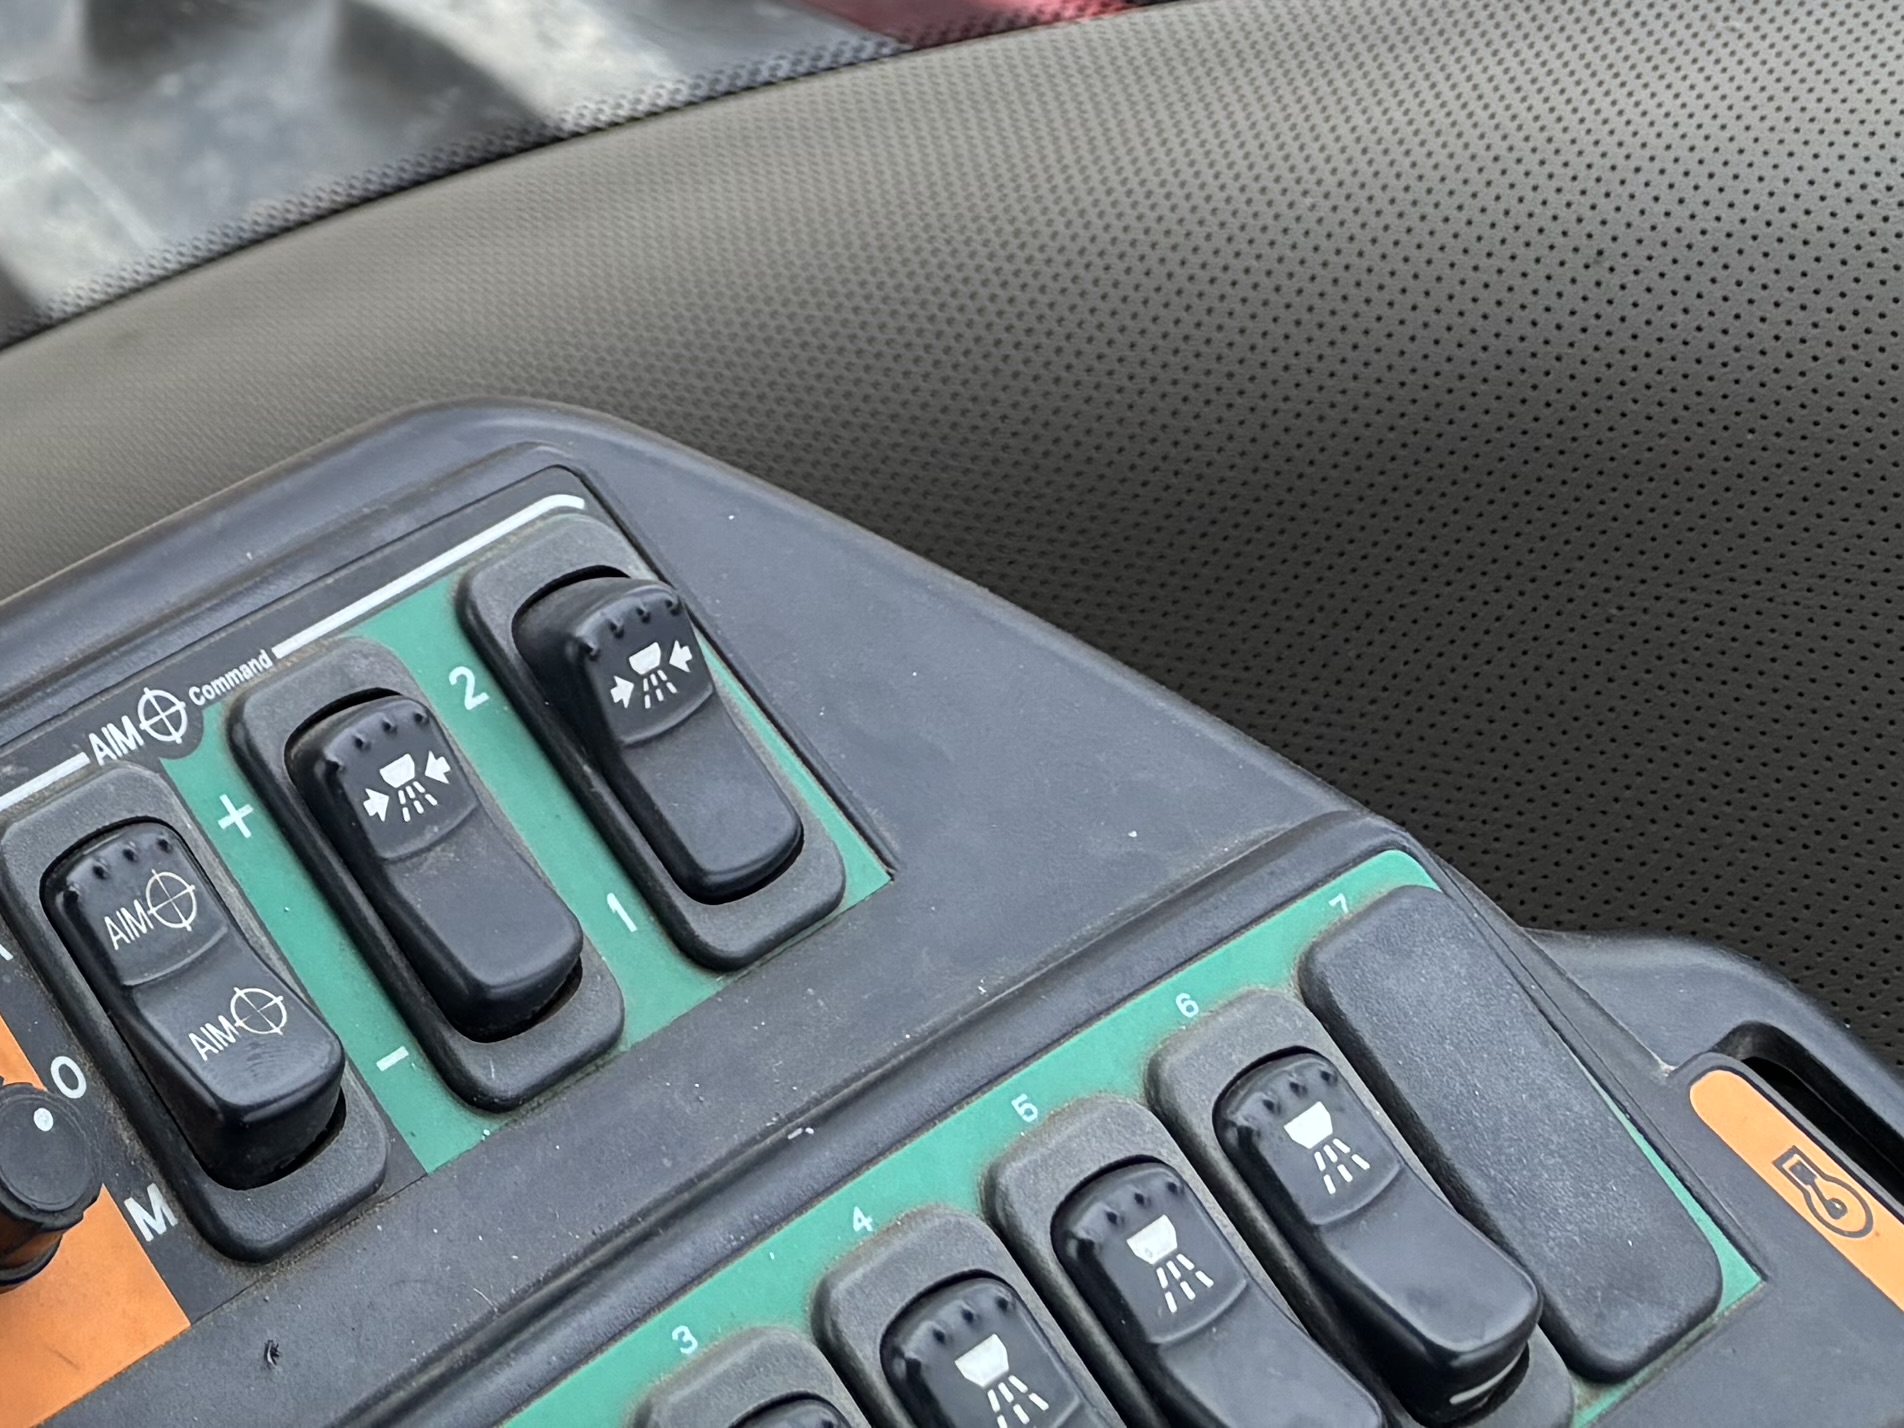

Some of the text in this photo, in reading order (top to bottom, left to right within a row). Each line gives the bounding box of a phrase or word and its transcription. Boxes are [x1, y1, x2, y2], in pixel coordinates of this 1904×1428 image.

[88, 650, 272, 767] AIM Command
[449, 666, 490, 711] 2
[103, 897, 152, 950] AIM
[606, 892, 637, 933] 1
[1329, 893, 1350, 914] 7
[1175, 992, 1199, 1018] 6
[188, 1014, 240, 1061] AIM
[1011, 1094, 1039, 1123] 5
[124, 1183, 179, 1242] M
[852, 1206, 873, 1232] 4
[672, 1325, 699, 1355] 3
